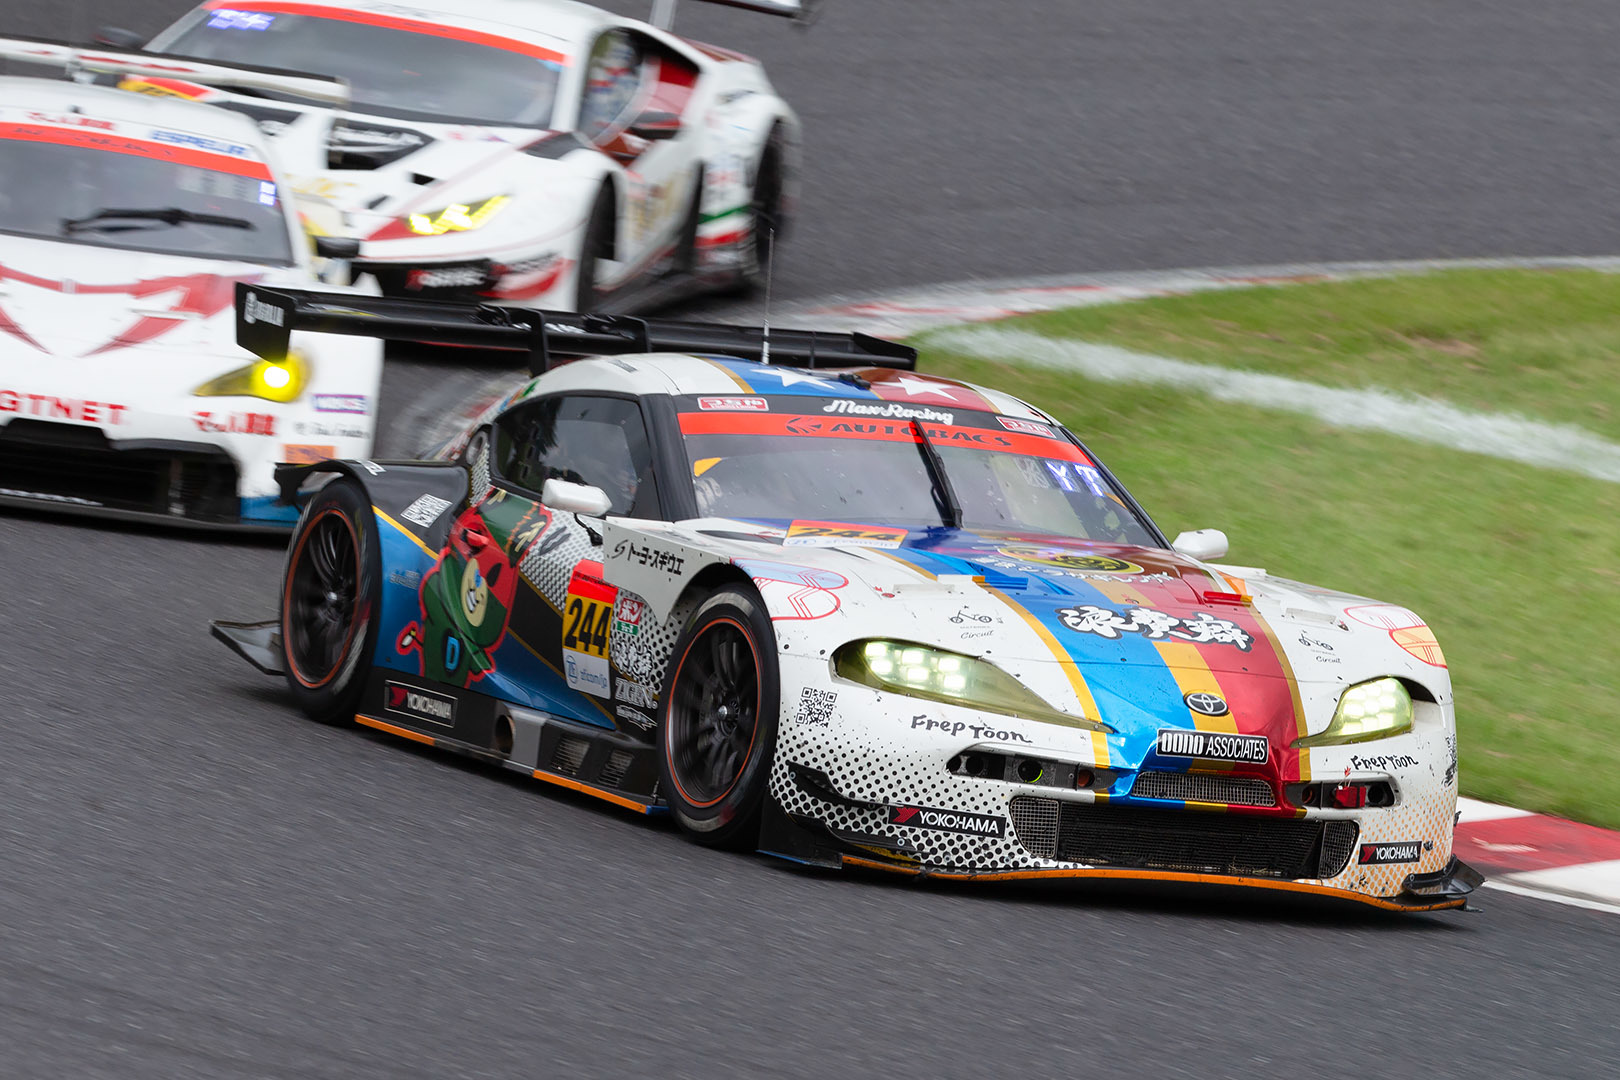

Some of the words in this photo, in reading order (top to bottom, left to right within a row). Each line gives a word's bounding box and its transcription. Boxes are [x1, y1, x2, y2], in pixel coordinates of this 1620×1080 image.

[828, 423, 1013, 447] AUTOBACS
[564, 597, 612, 656] 244
[1205, 735, 1266, 761] ASSOCIATES
[918, 809, 1000, 834] YOKOHAMA
[1375, 845, 1418, 861] YOKOHAMA
